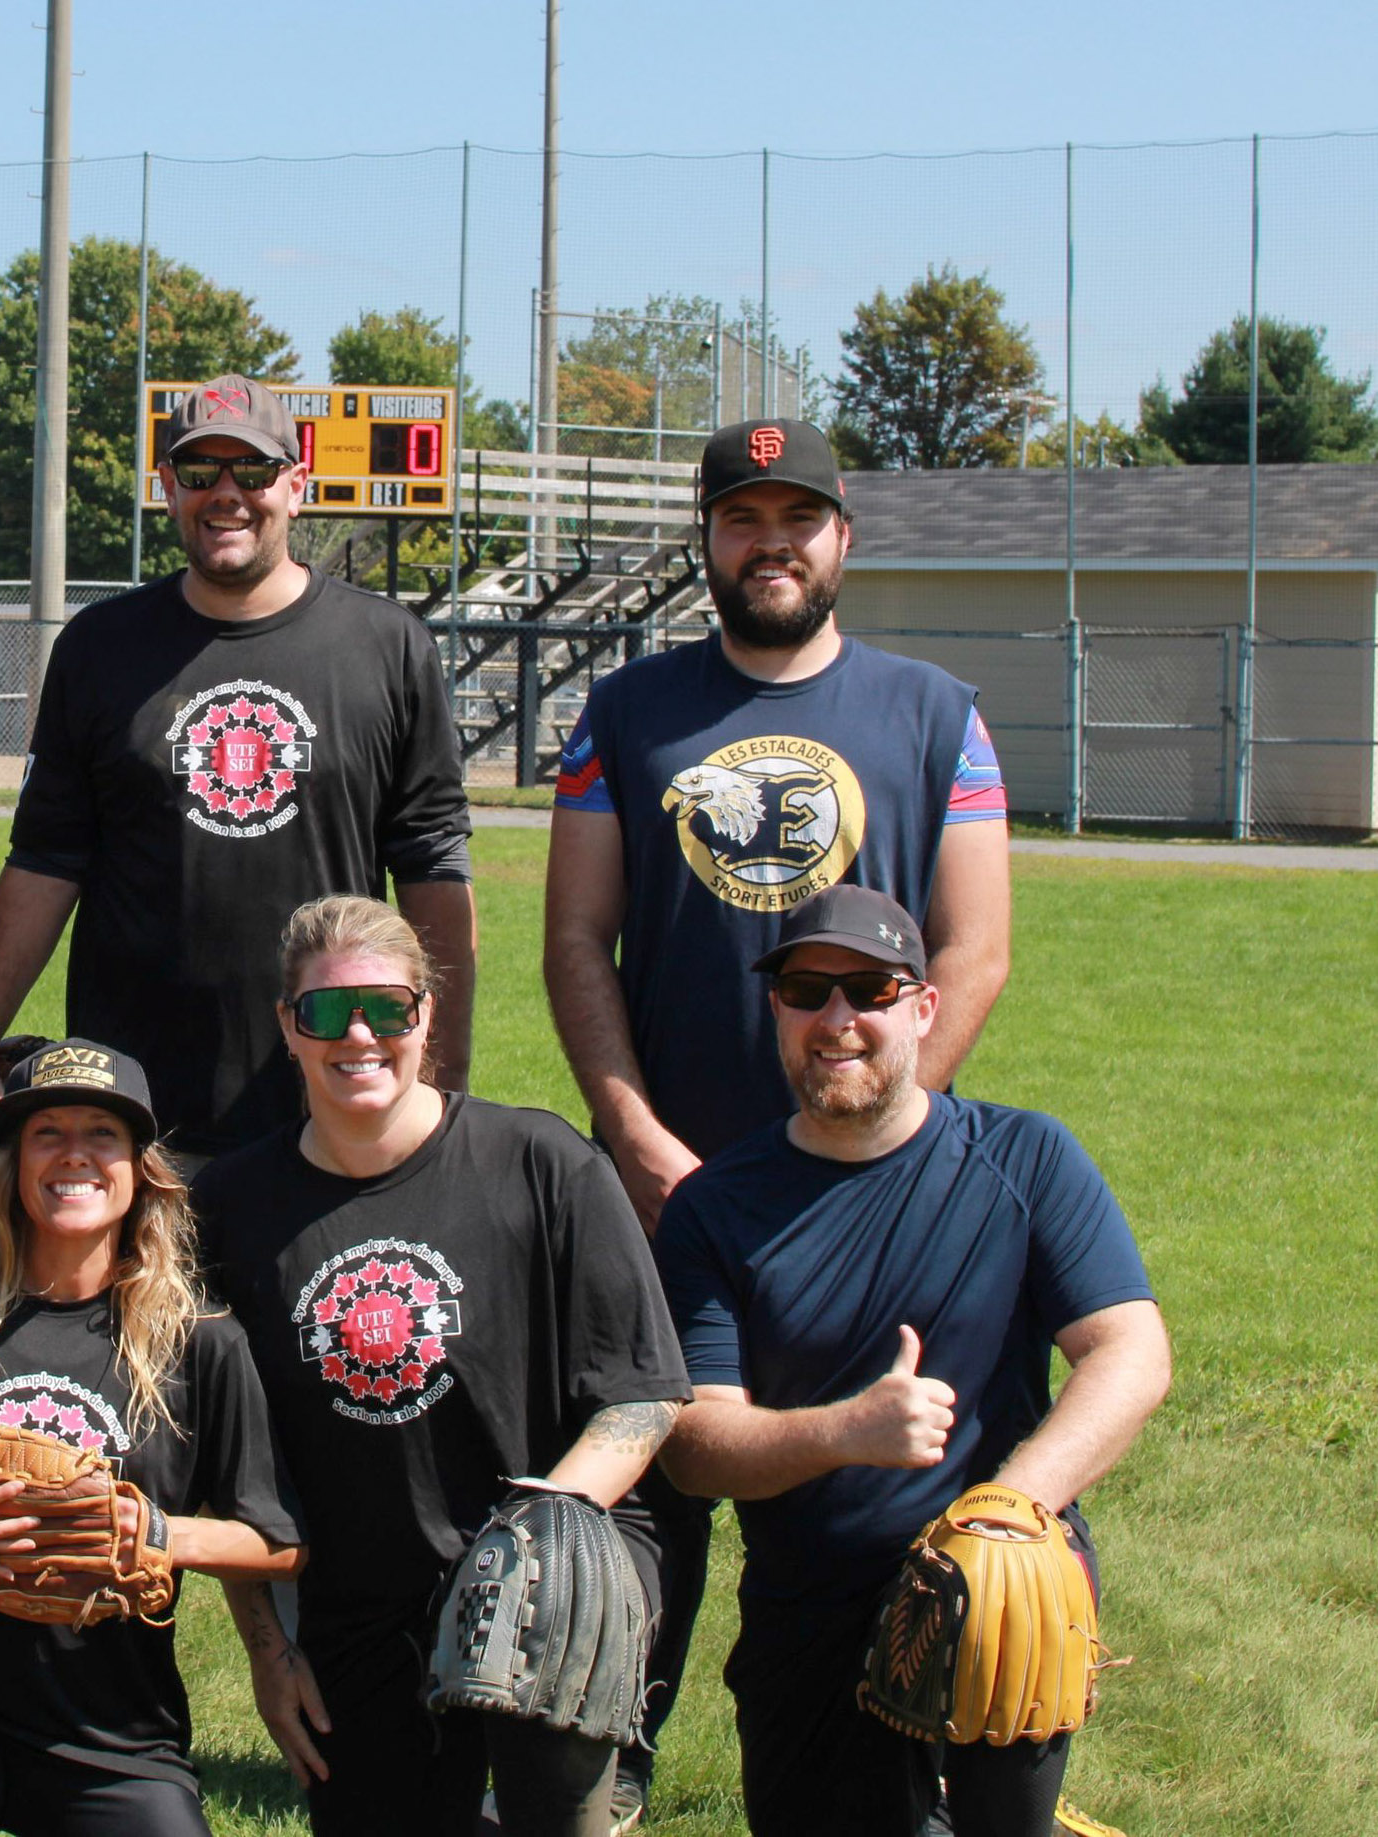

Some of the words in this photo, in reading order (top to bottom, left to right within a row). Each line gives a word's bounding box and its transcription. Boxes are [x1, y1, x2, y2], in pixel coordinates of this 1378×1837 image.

[276, 394, 329, 416] ANCHE
[371, 395, 443, 419] VISITEURS
[409, 424, 439, 474] 0
[165, 699, 199, 742] Syndicat
[196, 688, 215, 705] des
[279, 692, 295, 706] de
[226, 743, 257, 757] UTE
[719, 745, 747, 767] LES
[750, 740, 836, 770] ESTACADES
[229, 758, 254, 772] SEI
[186, 807, 229, 837] Section
[228, 823, 267, 838] locale
[266, 802, 299, 835] 10005
[36, 1047, 110, 1071] FXR
[291, 1271, 324, 1323] Syndicat
[322, 1254, 344, 1276] des
[412, 1243, 432, 1262] de
[357, 1309, 394, 1330] UTE
[362, 1329, 392, 1347] SEI
[87, 1392, 104, 1412] de
[332, 1398, 380, 1425] Section
[380, 1405, 419, 1425] locale
[417, 1373, 454, 1410] 10005
[963, 1493, 1017, 1508] Franklin
